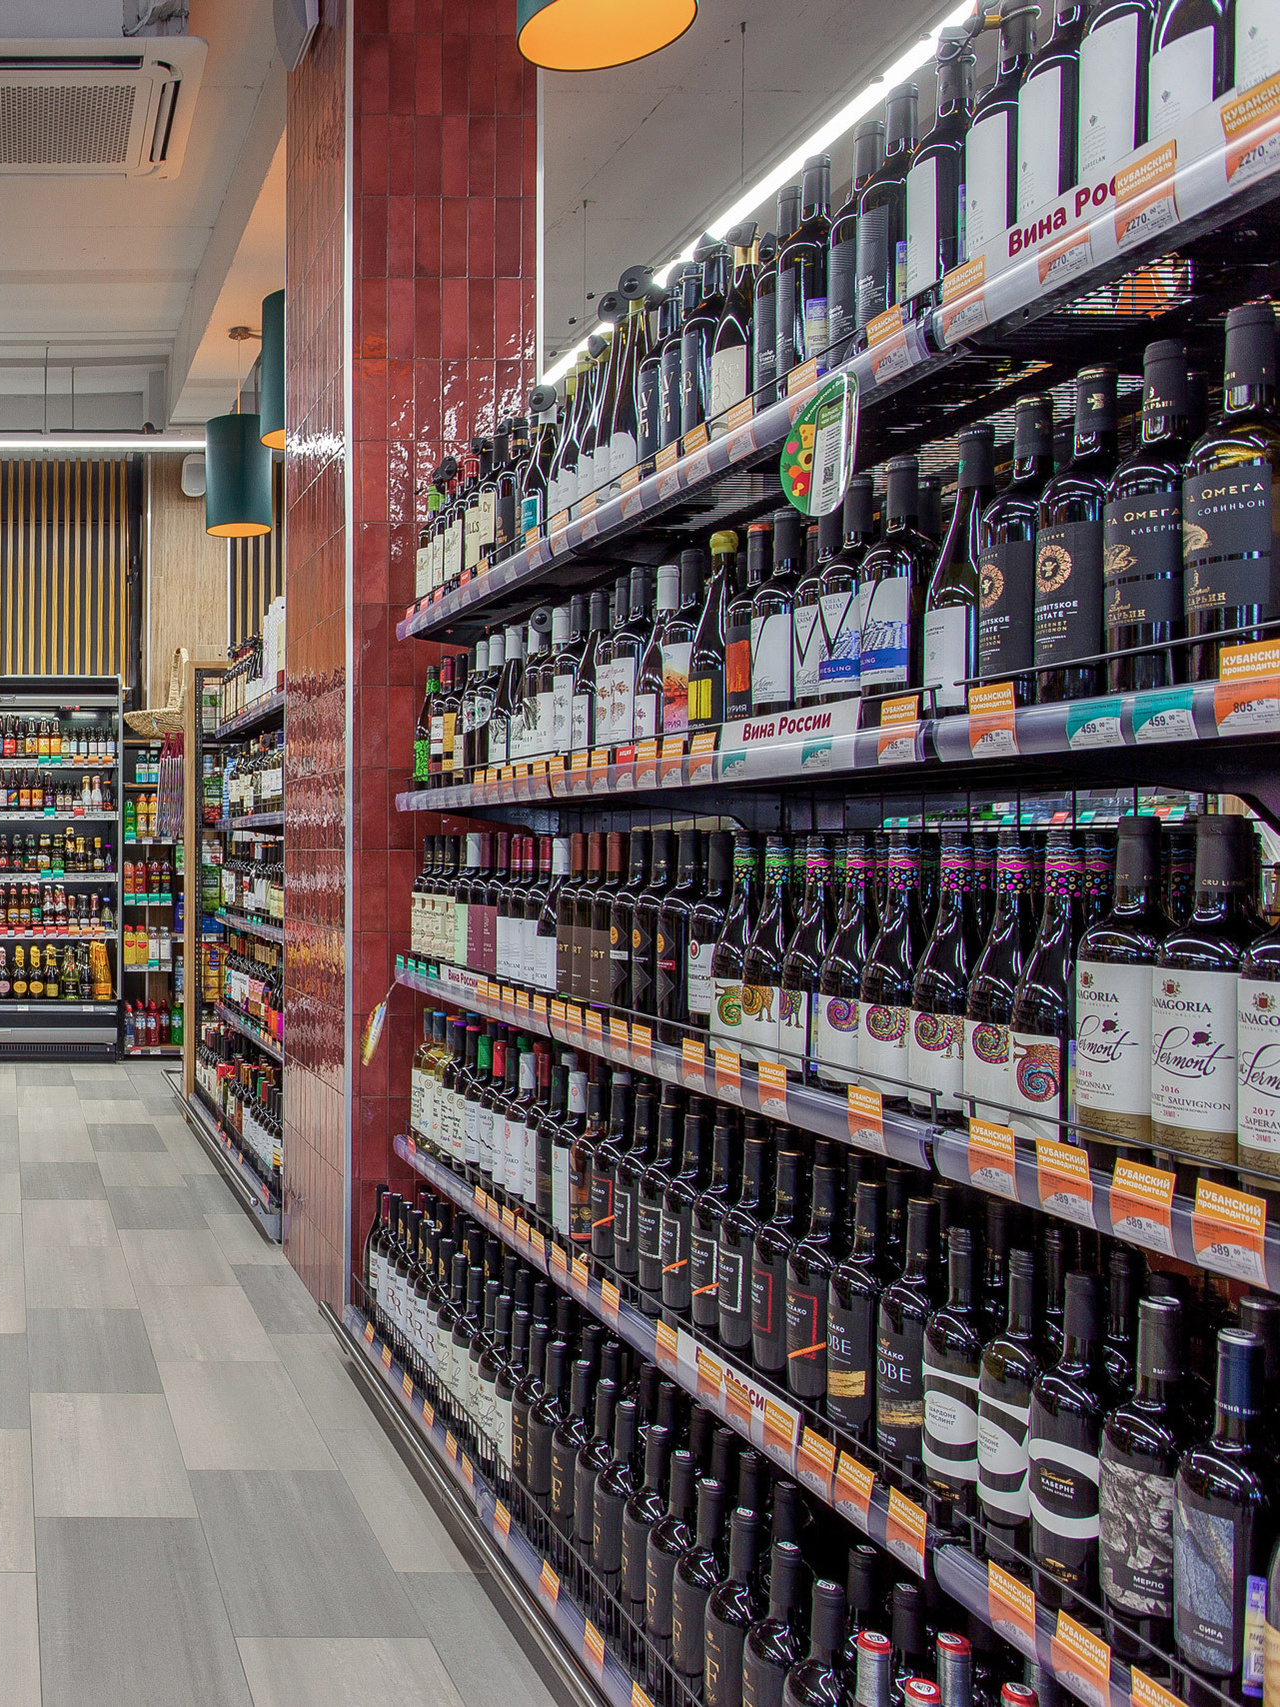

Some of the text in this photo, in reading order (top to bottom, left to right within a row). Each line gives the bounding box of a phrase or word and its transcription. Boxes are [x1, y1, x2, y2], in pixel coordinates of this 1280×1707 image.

[1223, 81, 1280, 122] КУБАНСКИ
[1238, 145, 1268, 168] 2270.
[1117, 150, 1173, 188] КУБАНСКИЙ
[1117, 162, 1172, 197] производитель
[1008, 175, 1116, 257] Вина Рос
[1126, 213, 1150, 233] 2270.
[1048, 253, 1069, 270] 2270.
[944, 260, 983, 288] КУБАНСКИЙ
[944, 270, 983, 295] производитель
[868, 311, 899, 333] КУБАНСКИЙ
[1197, 499, 1266, 517] СОВИНЬОН
[1188, 592, 1227, 606] АРЬИН
[1222, 649, 1280, 666] КУБАНСКИ
[970, 689, 1012, 702] КУБАНСКИЙ
[883, 703, 916, 715] КУБАНСКИЙ
[971, 699, 1012, 711] производитель
[1233, 701, 1256, 714] 805.
[883, 711, 915, 721] производитель
[1149, 716, 1169, 727] 459.
[743, 712, 832, 742] Вина России
[1081, 724, 1100, 734] 459.
[981, 734, 996, 743] 979.
[448, 969, 460, 983] Вина
[1077, 989, 1119, 1003] NAGORIA
[1153, 998, 1212, 1013] ANAGORIA
[760, 1066, 785, 1077] КУБАНСКИЙ
[1160, 1085, 1179, 1094] 2016
[849, 1092, 880, 1106] КУБАНСКИЙ
[1168, 1096, 1231, 1111] SAUVIGNON
[1252, 1107, 1275, 1117] 2017
[971, 1126, 1012, 1144] КУБАНСКИЙ
[971, 1134, 1012, 1150] производитель
[1038, 1145, 1086, 1166] КУБАНСКИЙ
[1039, 1155, 1086, 1174] производитель
[980, 1168, 996, 1180] 525.
[1116, 1166, 1171, 1190] КУБАНСКИЙ
[1115, 1176, 1169, 1198] производитель
[1054, 1192, 1072, 1206] 589.
[1199, 1188, 1262, 1216] КУБАНСКИЙ
[1198, 1199, 1260, 1226] производитель
[1126, 1216, 1146, 1231] 589.
[1211, 1243, 1233, 1258] 589.
[767, 1404, 793, 1427] КУБАНСКИЙ
[929, 1413, 955, 1425] РИСЛИНГ
[805, 1434, 833, 1458] КУБАНСКИЙ
[841, 1459, 870, 1484] КУБАНСКИЙ
[1041, 1477, 1075, 1494] КАБЕРНЕ
[891, 1494, 924, 1525] КУБАНСКИЙ
[990, 1569, 1032, 1606] КУБАНСКИЙ
[1133, 1575, 1165, 1589] МЕРЛО
[990, 1579, 1032, 1613] производитель
[1199, 1624, 1223, 1639] СИРА
[1059, 1620, 1108, 1662] КУБАНСКИЙ
[1059, 1629, 1106, 1669] производитель
